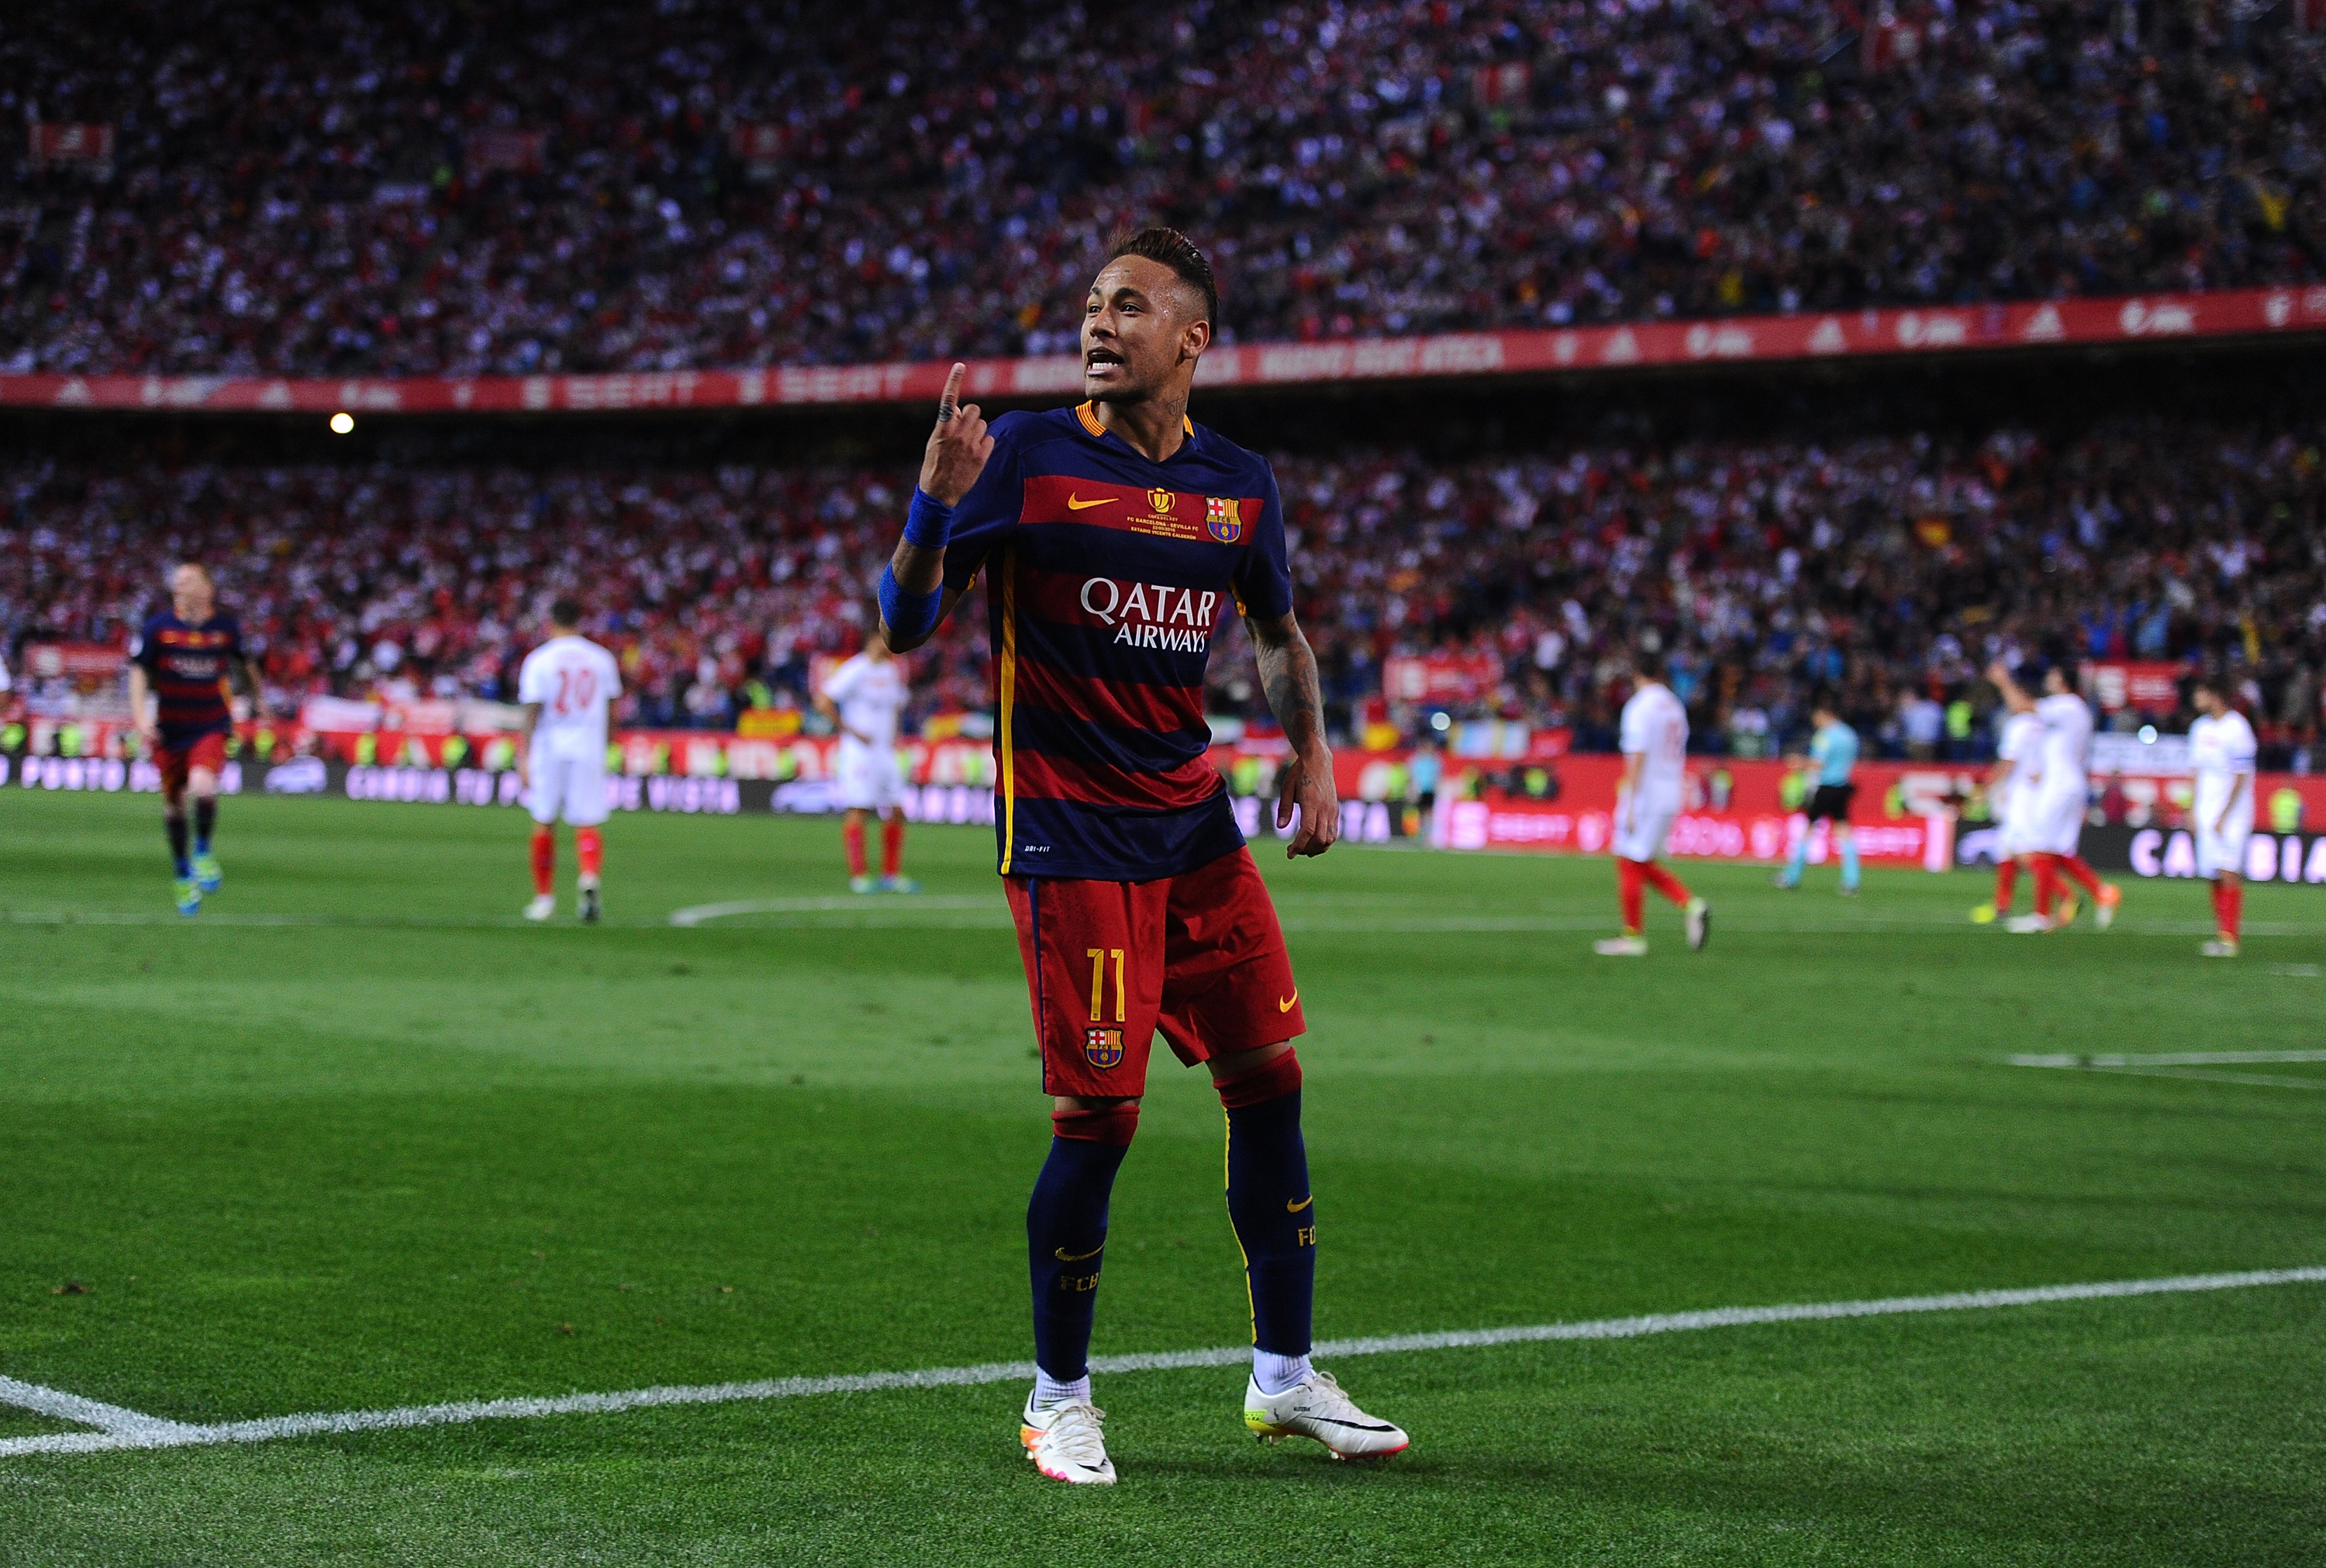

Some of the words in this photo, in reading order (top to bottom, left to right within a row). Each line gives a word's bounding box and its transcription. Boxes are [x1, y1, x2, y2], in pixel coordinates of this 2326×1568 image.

[1135, 518, 1166, 527] BARCELONA
[1080, 577, 1216, 627] QATAR
[1113, 622, 1207, 653] AIRWAYS
[2129, 828, 2326, 884] CABIA
[1087, 948, 1125, 1022] 11
[1061, 1272, 1099, 1292] FCB
